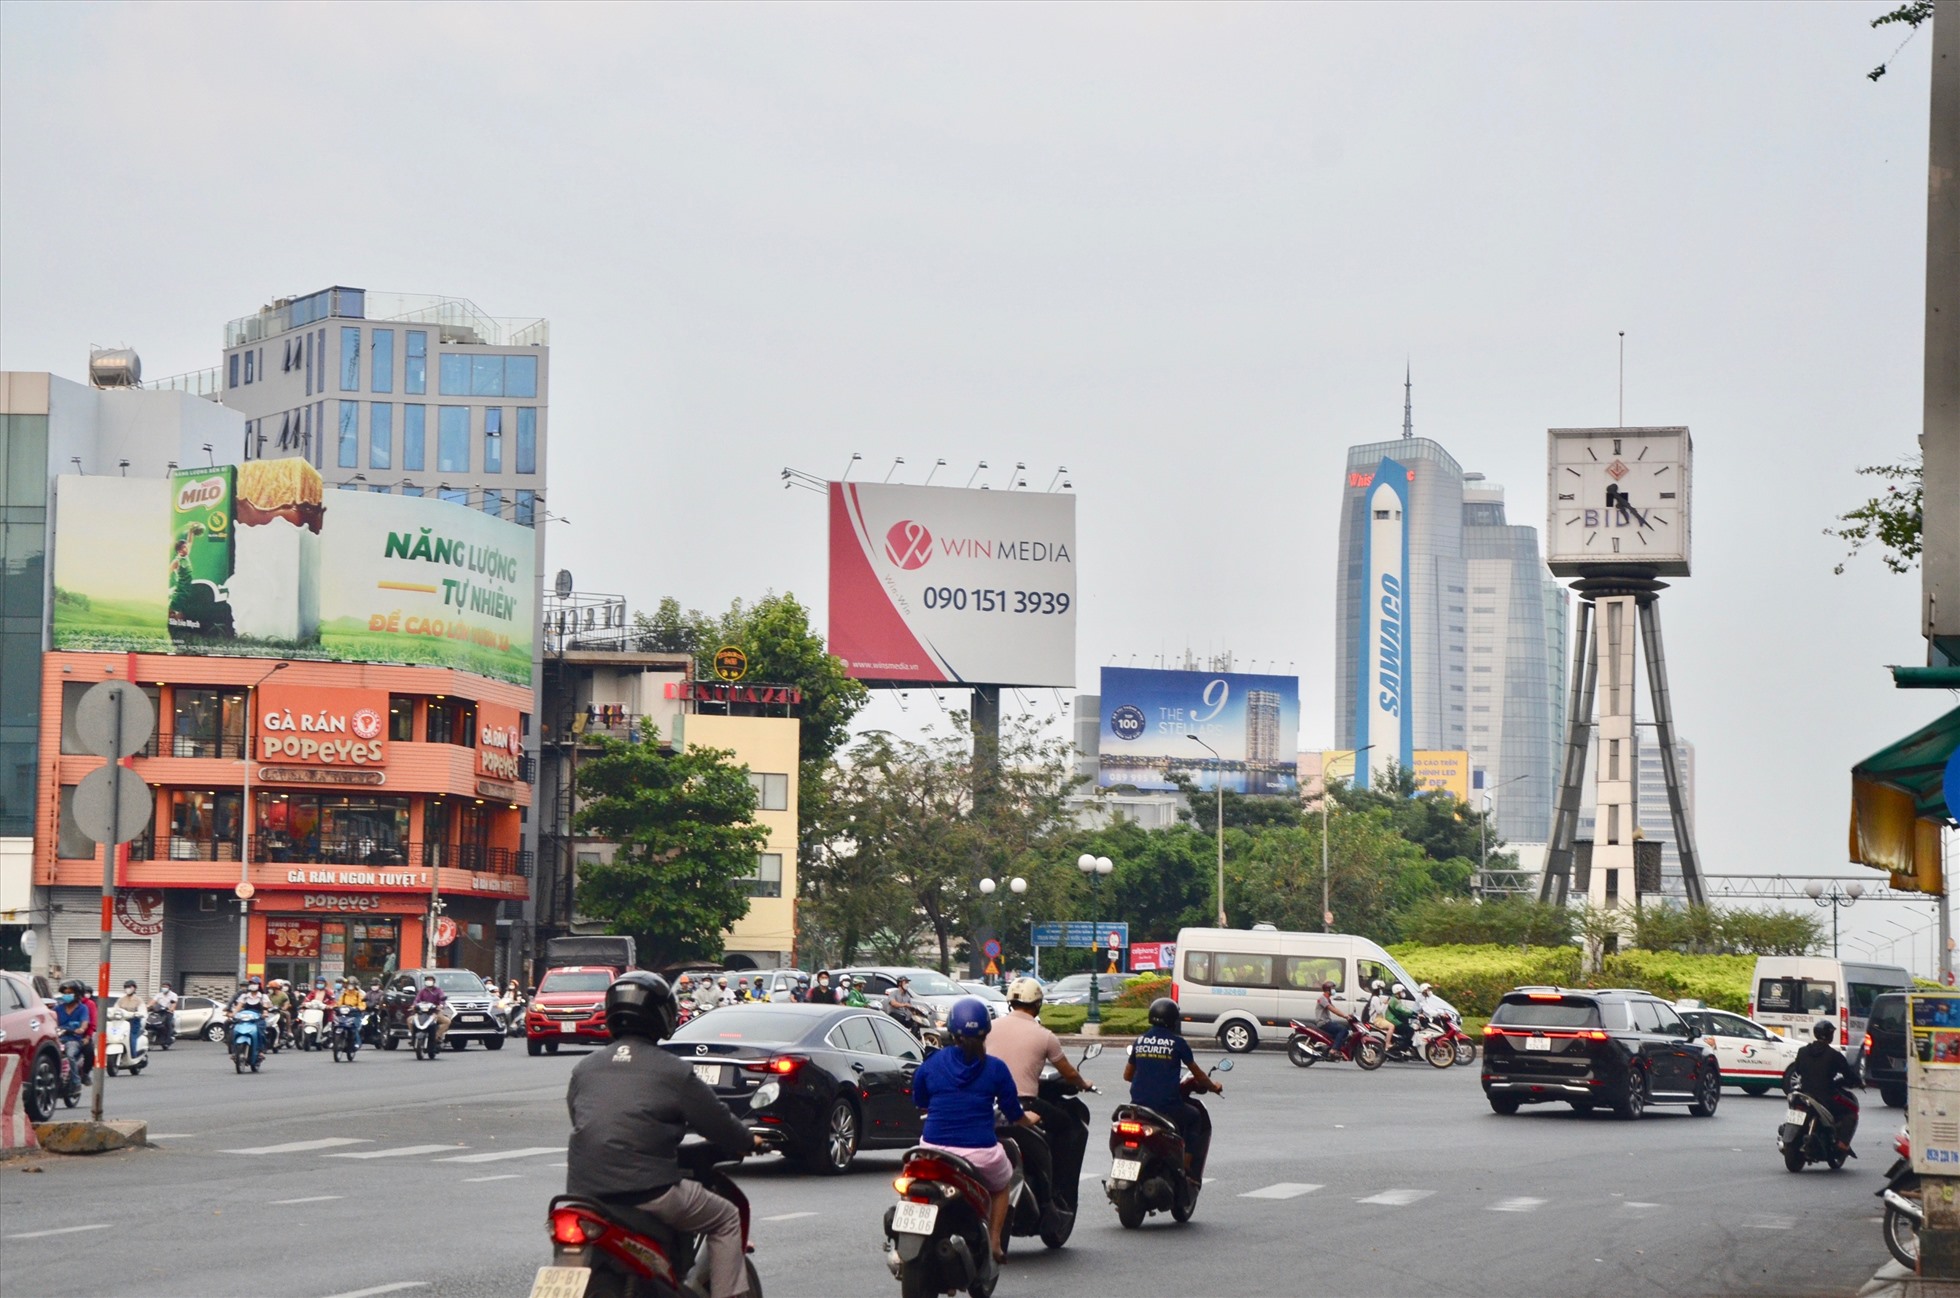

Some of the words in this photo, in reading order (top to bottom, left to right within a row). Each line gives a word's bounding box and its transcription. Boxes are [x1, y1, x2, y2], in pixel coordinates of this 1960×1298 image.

[181, 486, 221, 505] MILO
[384, 527, 465, 567] NĂNG
[468, 543, 517, 584] LƯỢNG
[940, 537, 992, 559] WIN
[997, 541, 1071, 562] MEDIA
[442, 578, 469, 615] TỰ
[923, 587, 967, 611] 090
[971, 589, 1006, 612] 151
[1014, 591, 1070, 615] 3939
[368, 609, 403, 633] ĐỂ
[405, 616, 444, 637] CAO
[1379, 573, 1400, 718] SAWACO
[1190, 679, 1230, 722] 9
[264, 708, 297, 731] GÀ
[301, 710, 346, 733] RÁN
[1118, 719, 1138, 730] 100
[1159, 707, 1184, 721] THE
[287, 868, 305, 883] GÀ
[309, 868, 336, 884] RÁN
[339, 872, 375, 885] NGON
[378, 871, 417, 887] TUYỆT
[1135, 1045, 1174, 1055] SECURITY
